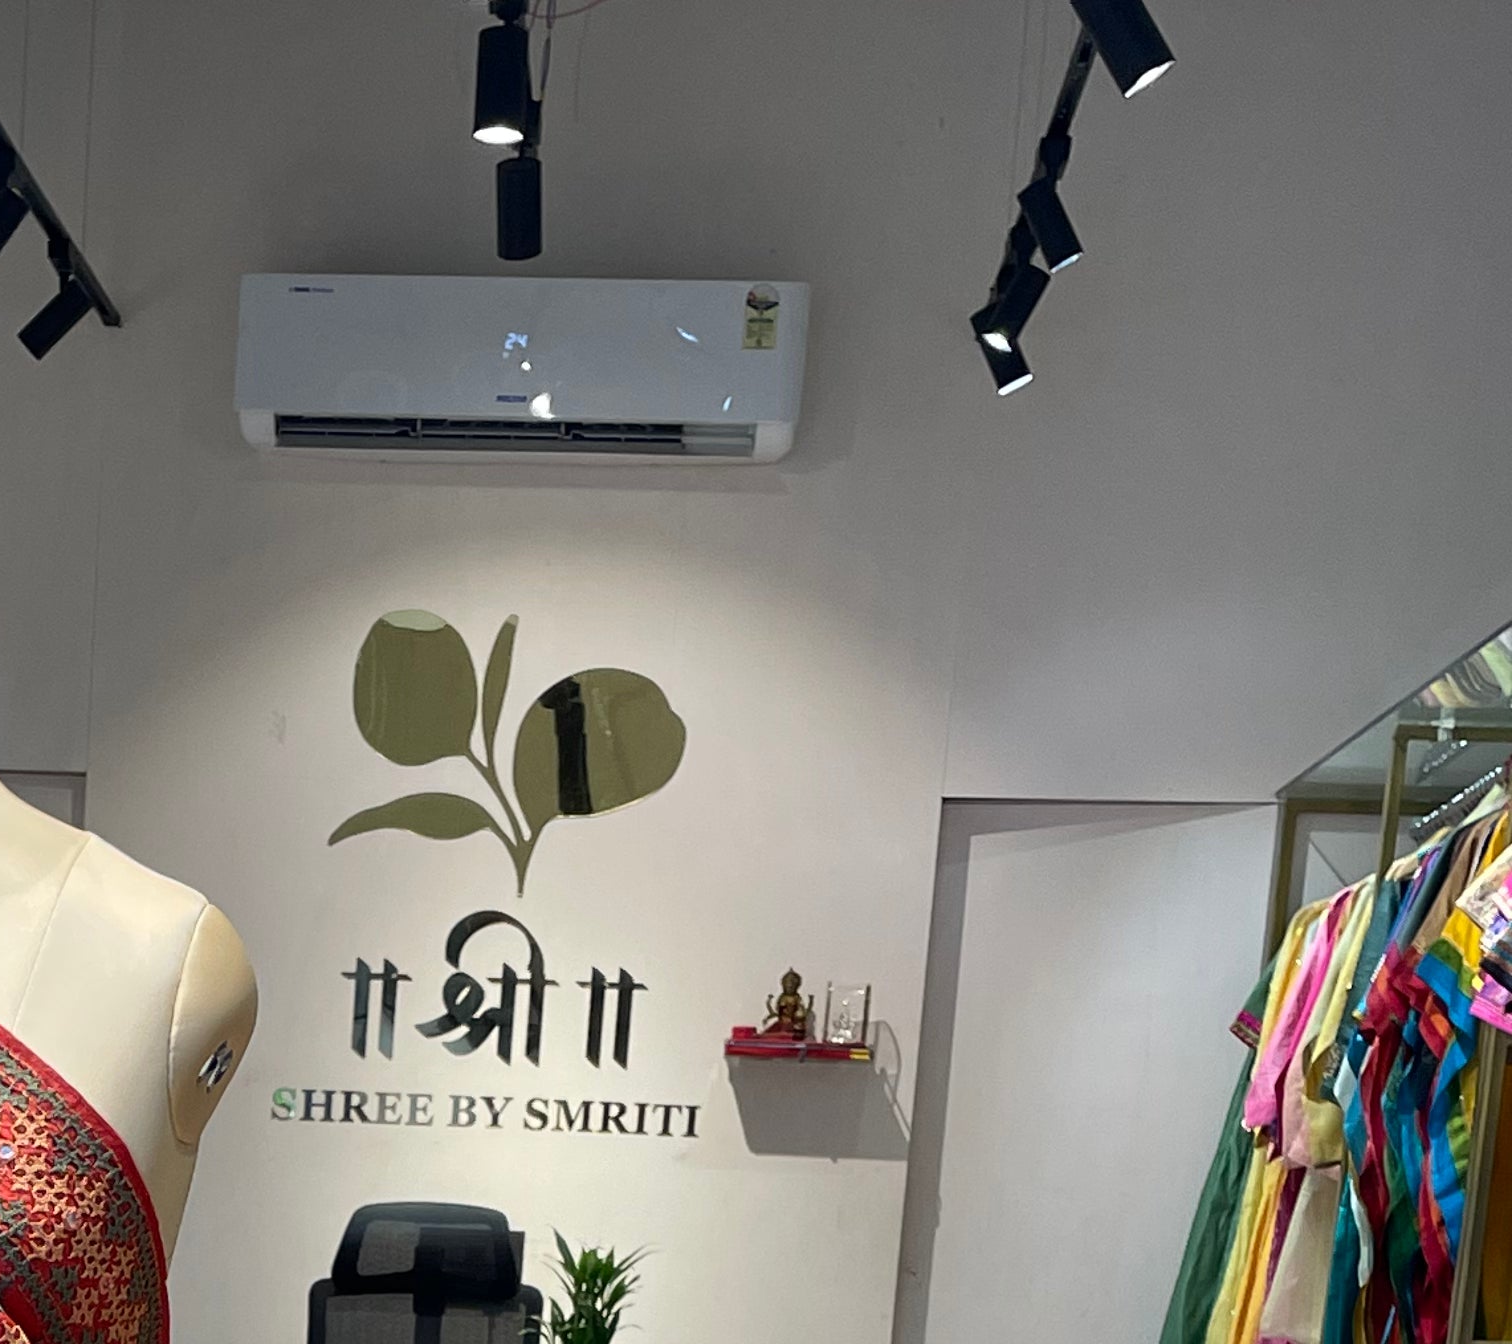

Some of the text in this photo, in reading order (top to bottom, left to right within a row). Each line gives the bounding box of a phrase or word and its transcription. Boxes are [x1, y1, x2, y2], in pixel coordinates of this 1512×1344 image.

[504, 332, 529, 350] 24
[414, 909, 560, 1067] श्री
[271, 1086, 701, 1138] SHREE BY SMRITI
